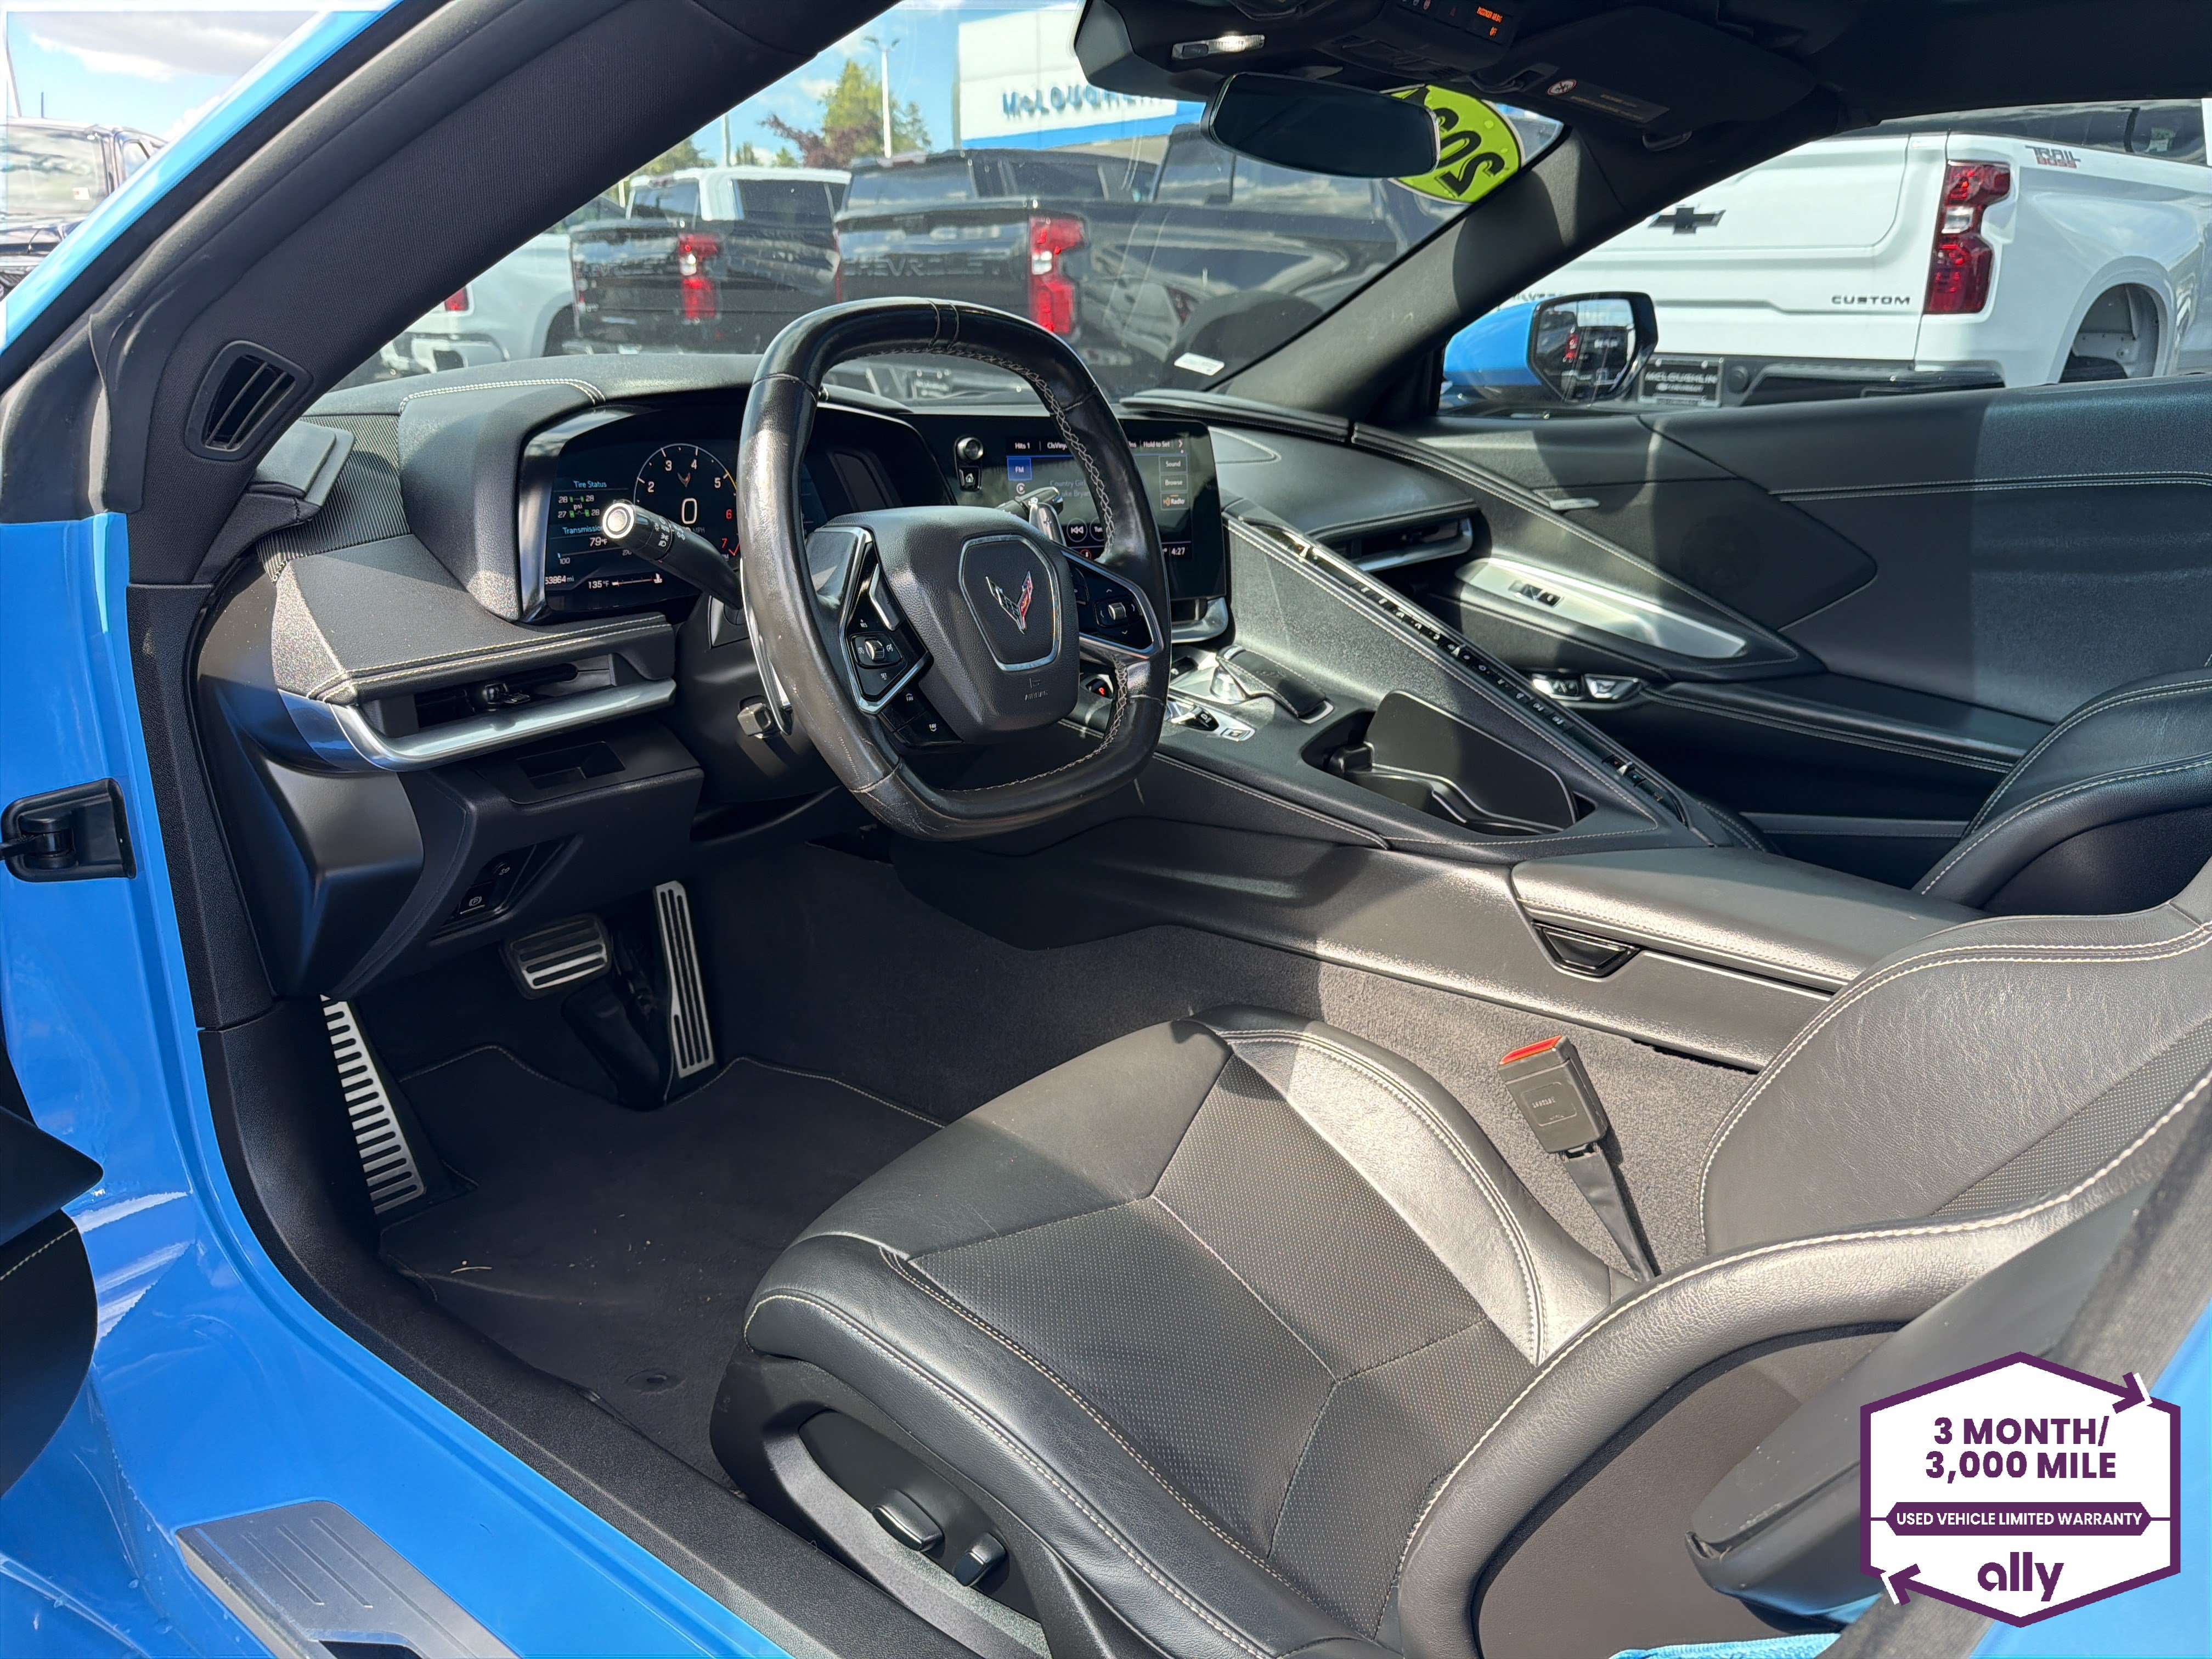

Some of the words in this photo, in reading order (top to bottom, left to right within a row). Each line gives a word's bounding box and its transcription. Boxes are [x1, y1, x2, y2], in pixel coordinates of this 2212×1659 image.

[2025, 145, 2081, 163] TRAIL
[1831, 295, 1910, 305] CUSTOM
[665, 460, 672, 471] 3
[691, 459, 697, 470] 4
[647, 481, 654, 493] 2
[714, 477, 721, 488] 5
[681, 498, 698, 524] 0
[726, 509, 732, 520] 6
[562, 526, 603, 535] Transmissio
[721, 538, 727, 549] 7
[1171, 546, 1186, 556] 4:27
[545, 575, 567, 585] 53864
[588, 580, 610, 589] 135°F
